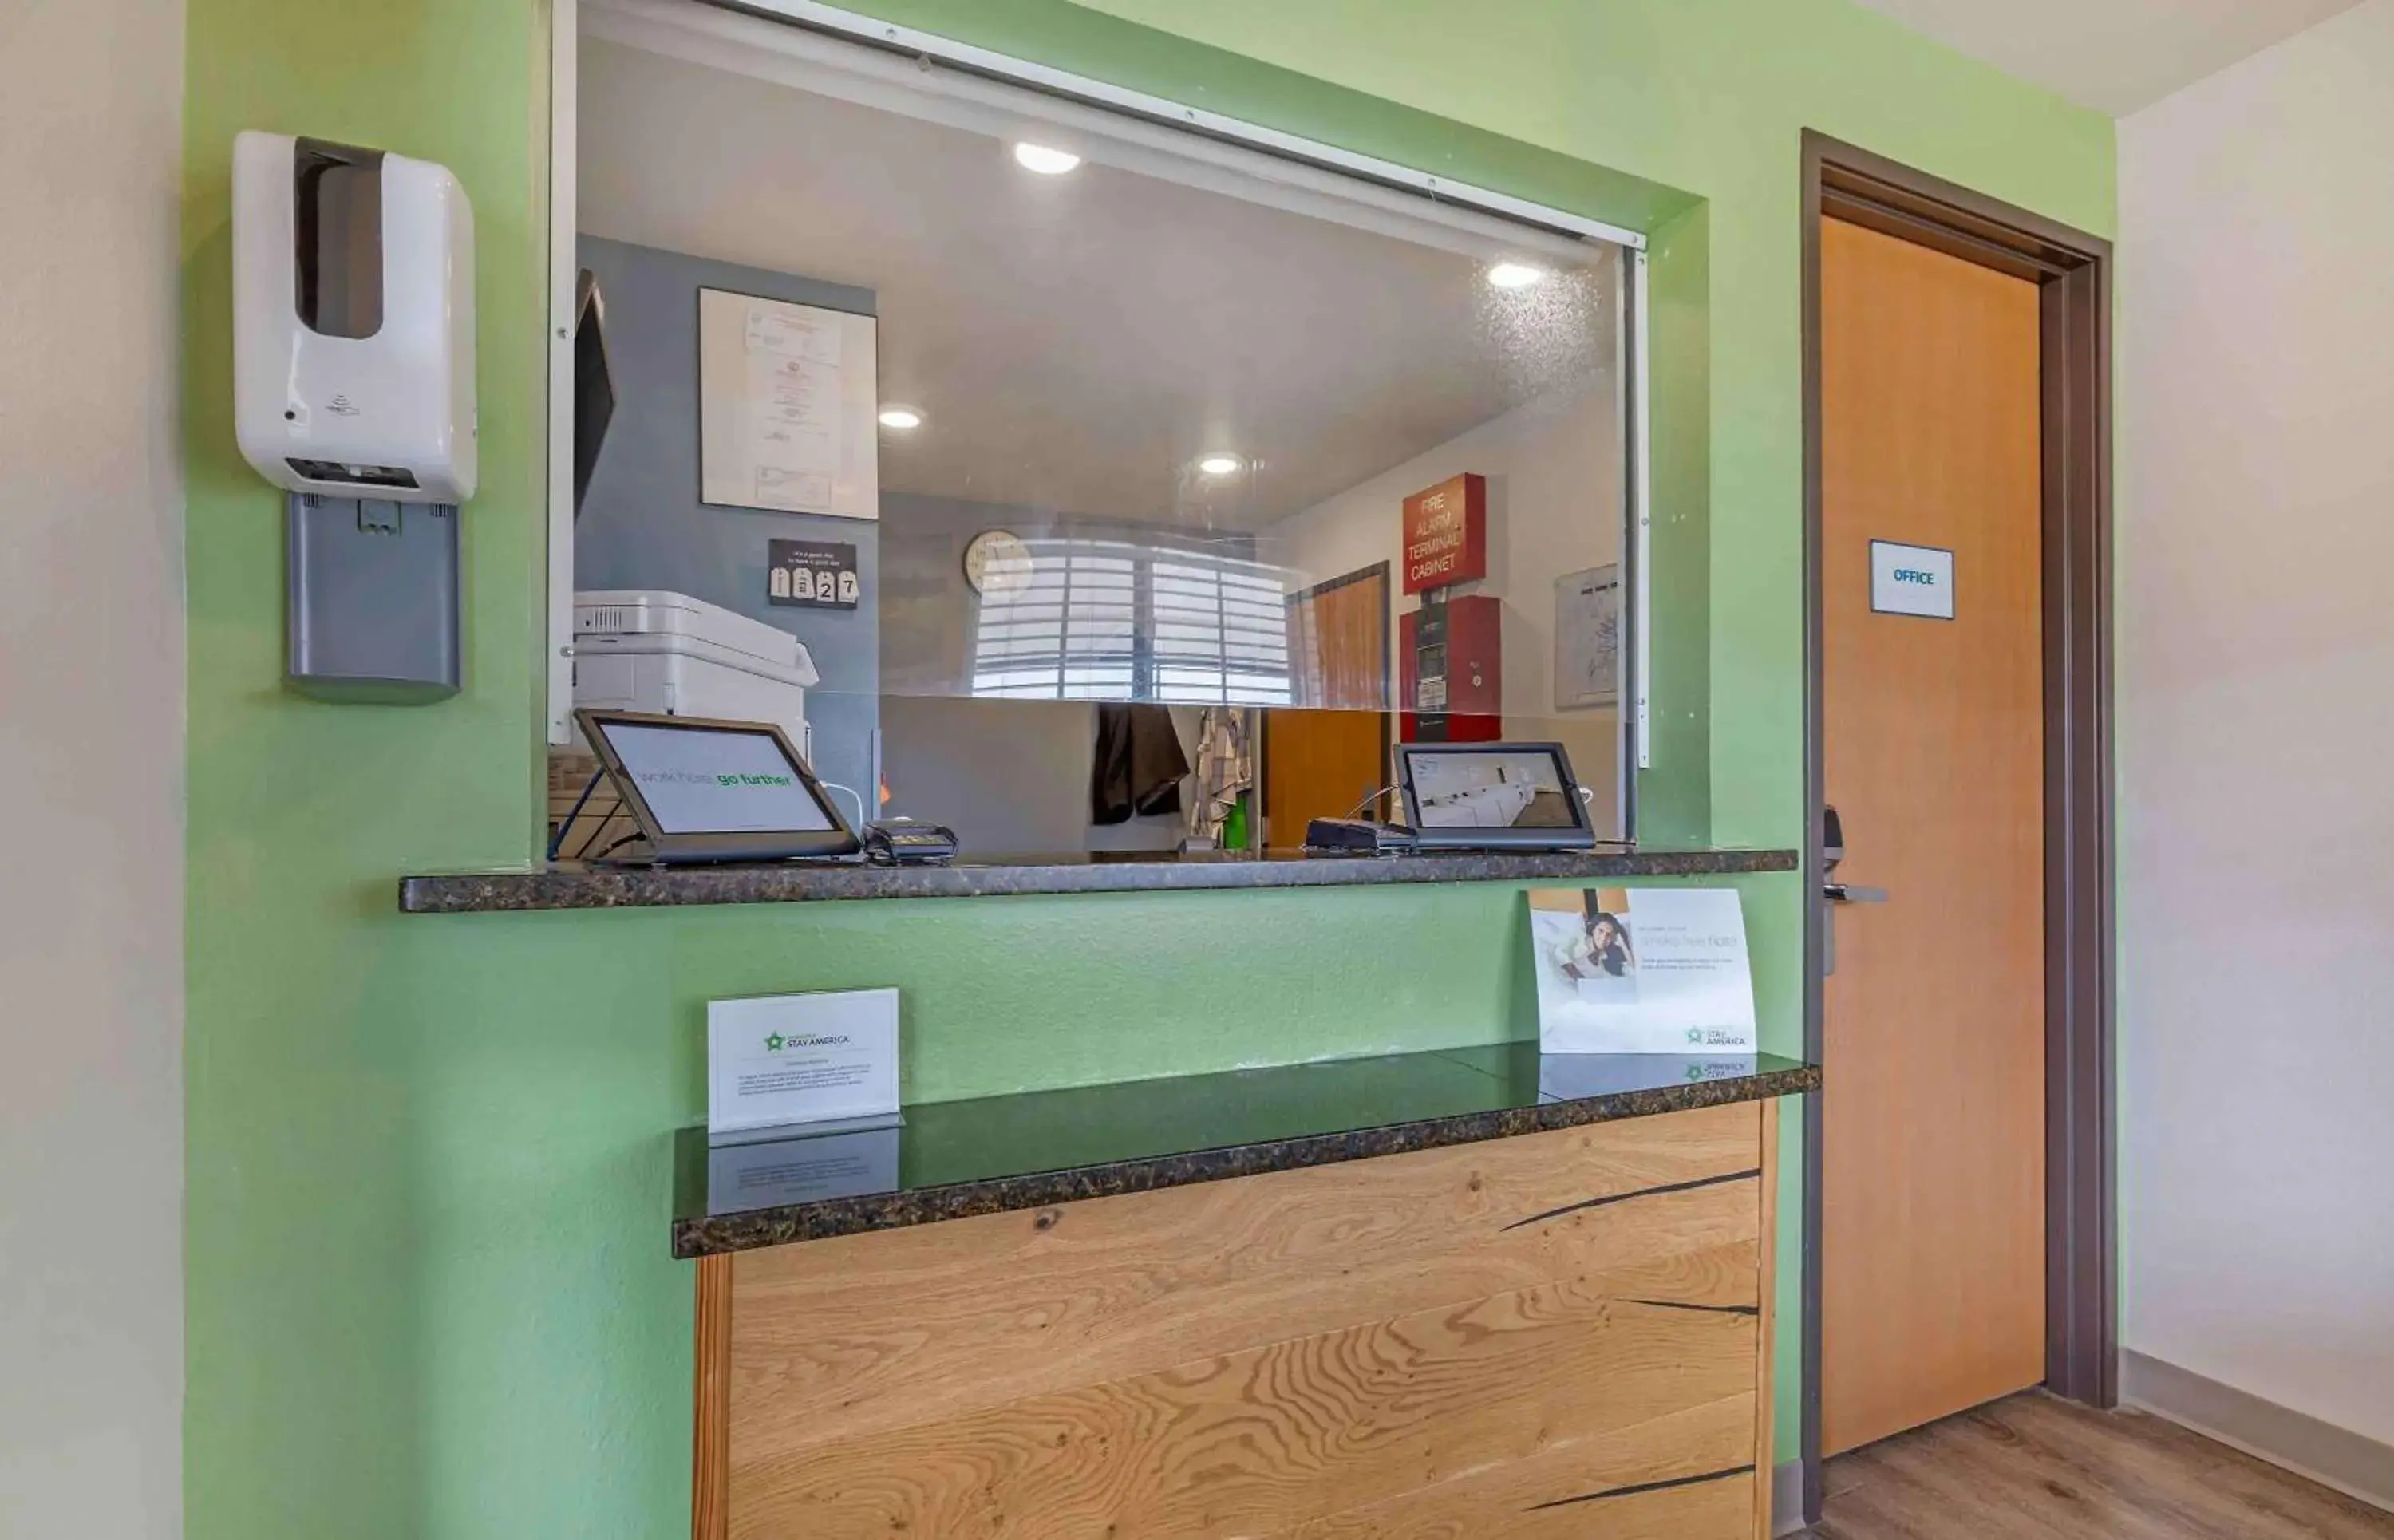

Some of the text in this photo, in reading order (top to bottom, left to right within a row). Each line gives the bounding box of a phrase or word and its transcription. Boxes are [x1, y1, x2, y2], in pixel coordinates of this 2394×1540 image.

[1408, 532, 1460, 561] TERMINAL
[1411, 553, 1455, 581] CABINET
[1893, 569, 1934, 584] OFFICE
[717, 773, 739, 786] go
[741, 773, 791, 787] further
[786, 1040, 808, 1048] STAY
[808, 1034, 850, 1047] AMERICA
